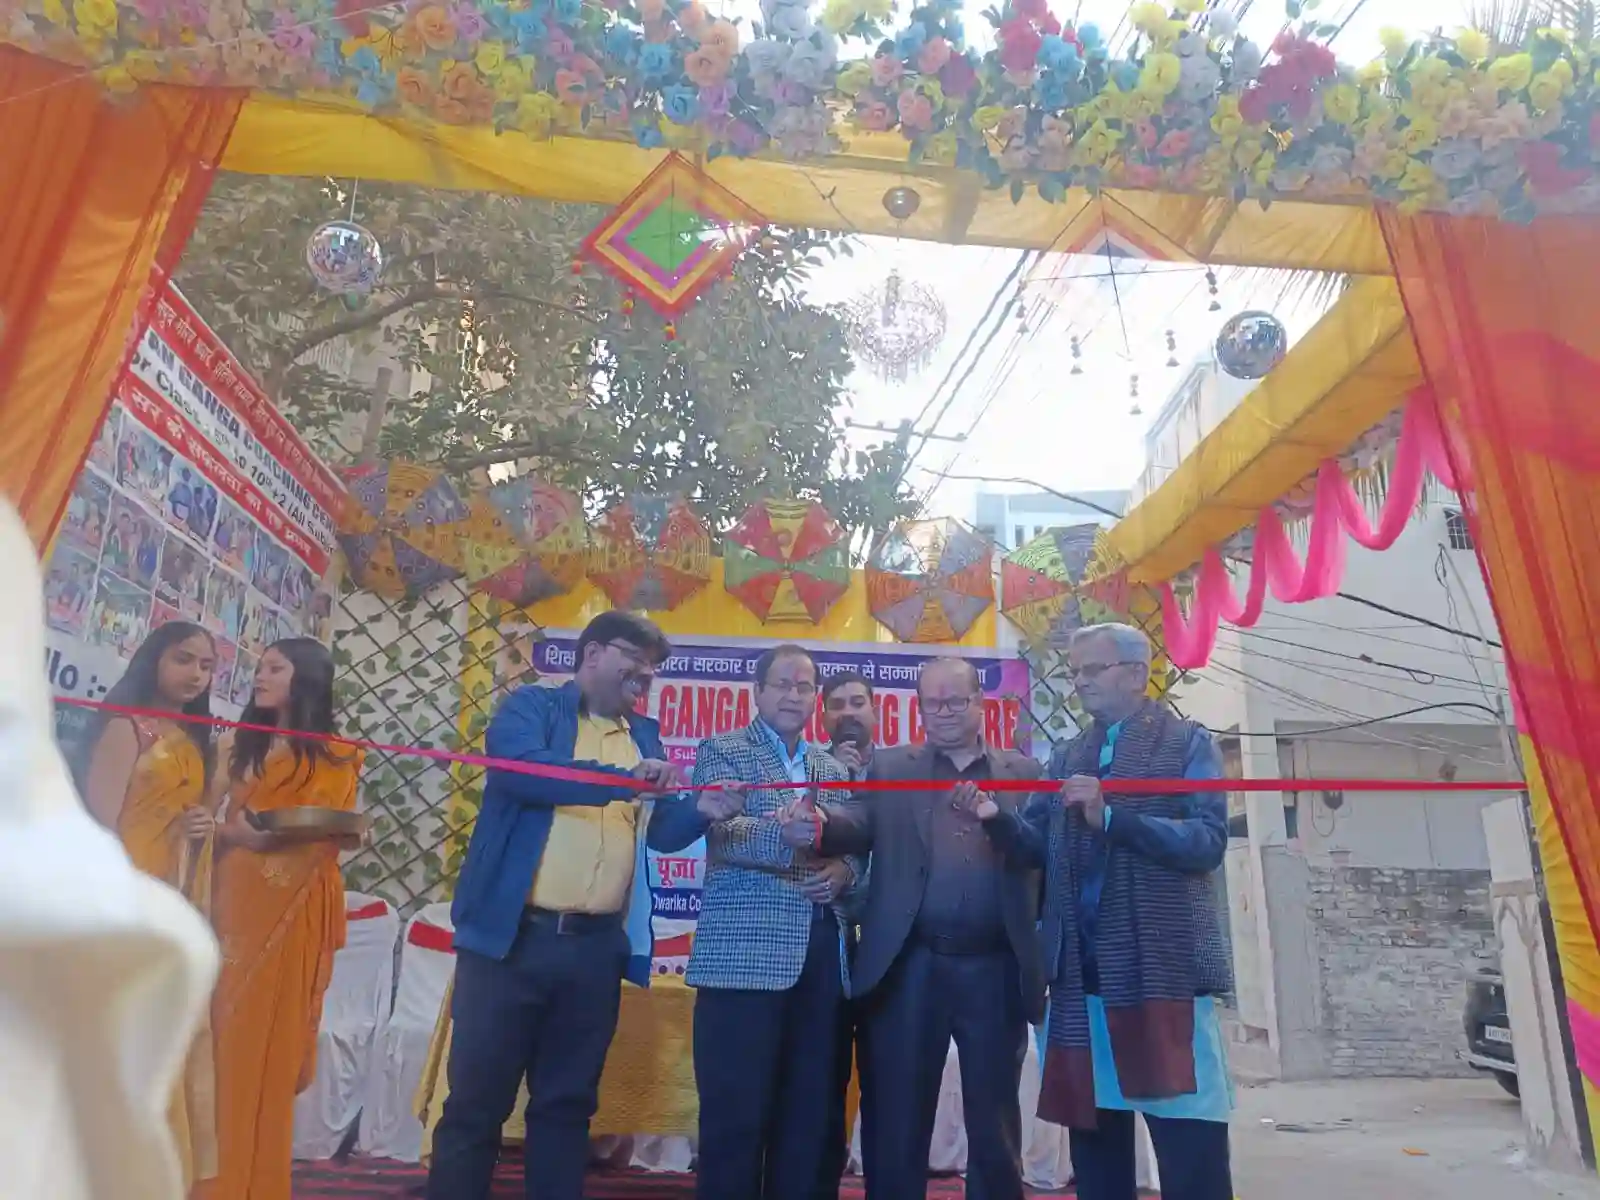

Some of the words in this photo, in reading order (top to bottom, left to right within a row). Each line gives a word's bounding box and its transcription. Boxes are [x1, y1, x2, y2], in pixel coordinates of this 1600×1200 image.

[178, 365, 240, 438] GANGA
[692, 656, 743, 676] सरकार
[862, 660, 877, 681] से
[659, 686, 749, 738] GANGA
[656, 856, 699, 888] पूजा
